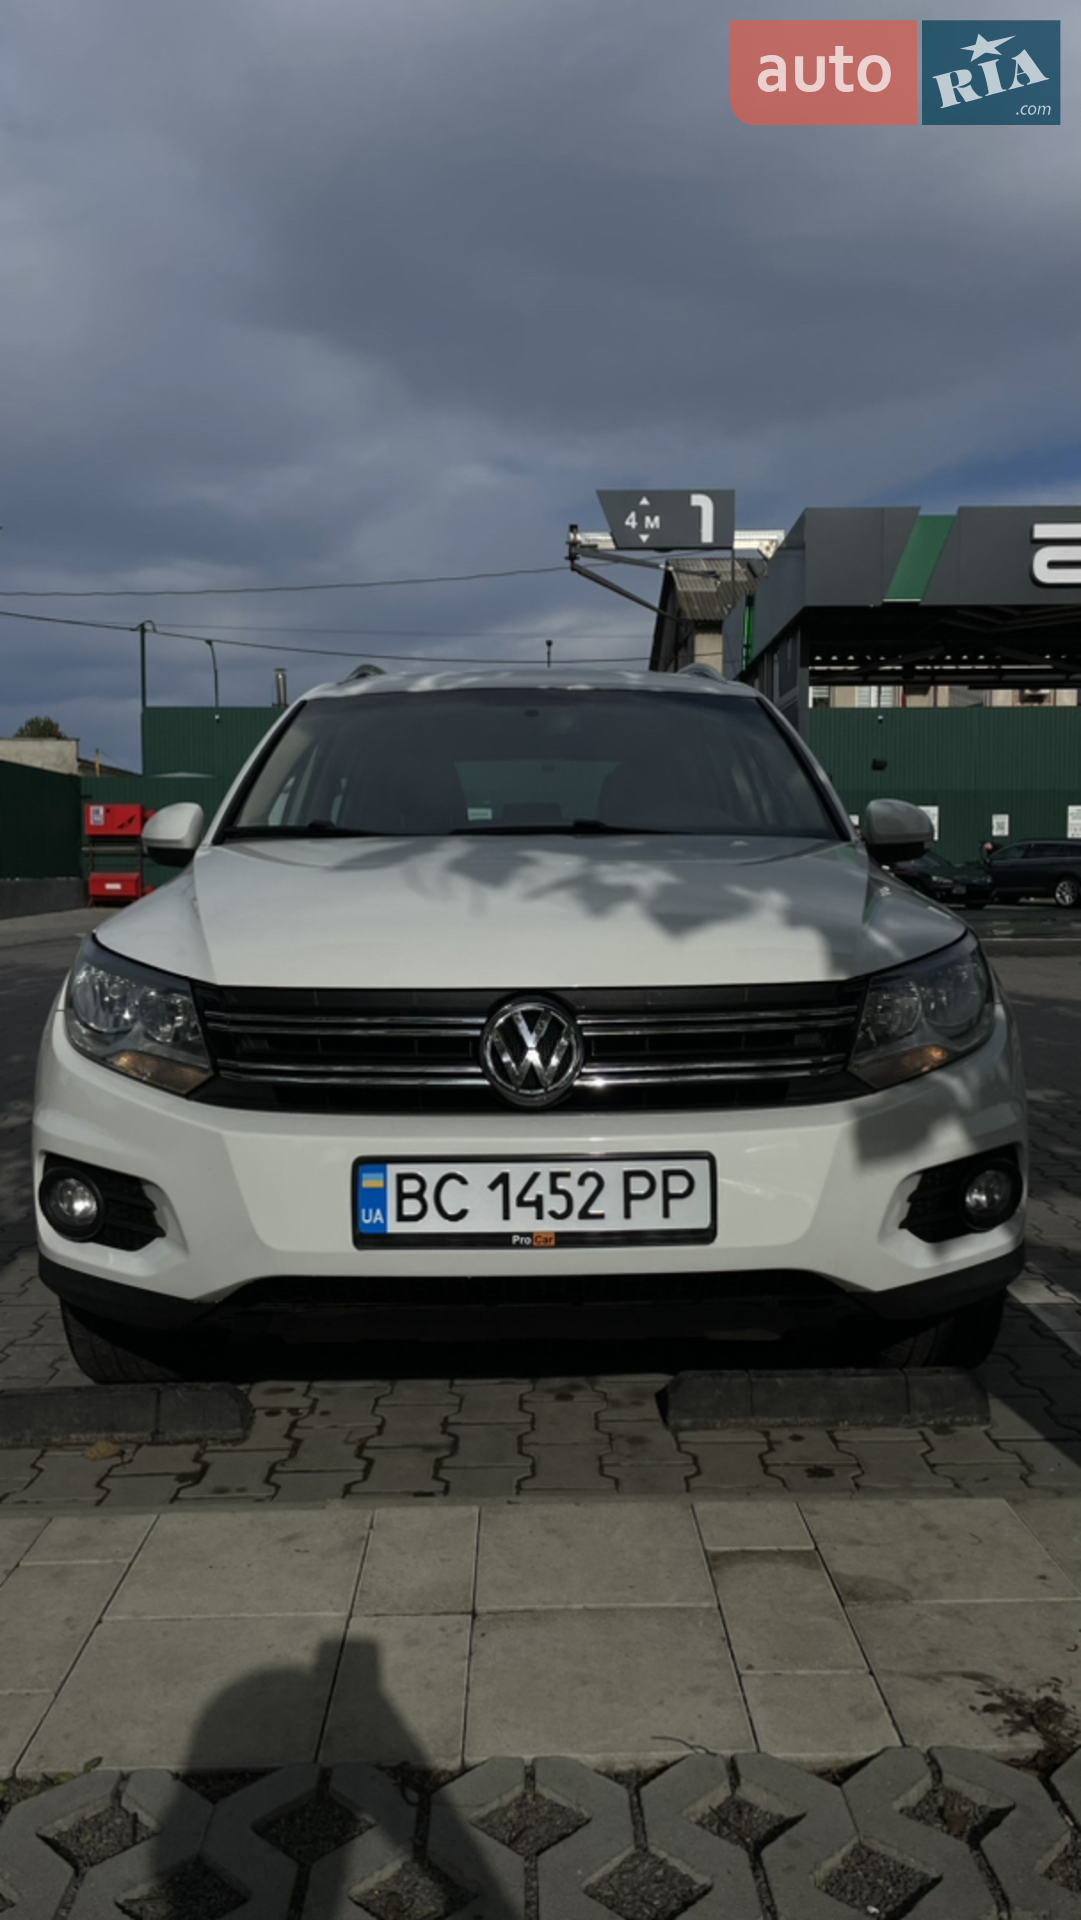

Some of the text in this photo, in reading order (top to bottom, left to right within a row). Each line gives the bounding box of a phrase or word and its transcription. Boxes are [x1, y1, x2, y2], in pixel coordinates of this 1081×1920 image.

[624, 511, 638, 529] 4
[487, 1170, 606, 1221] 1452
[361, 1208, 384, 1224] UA
